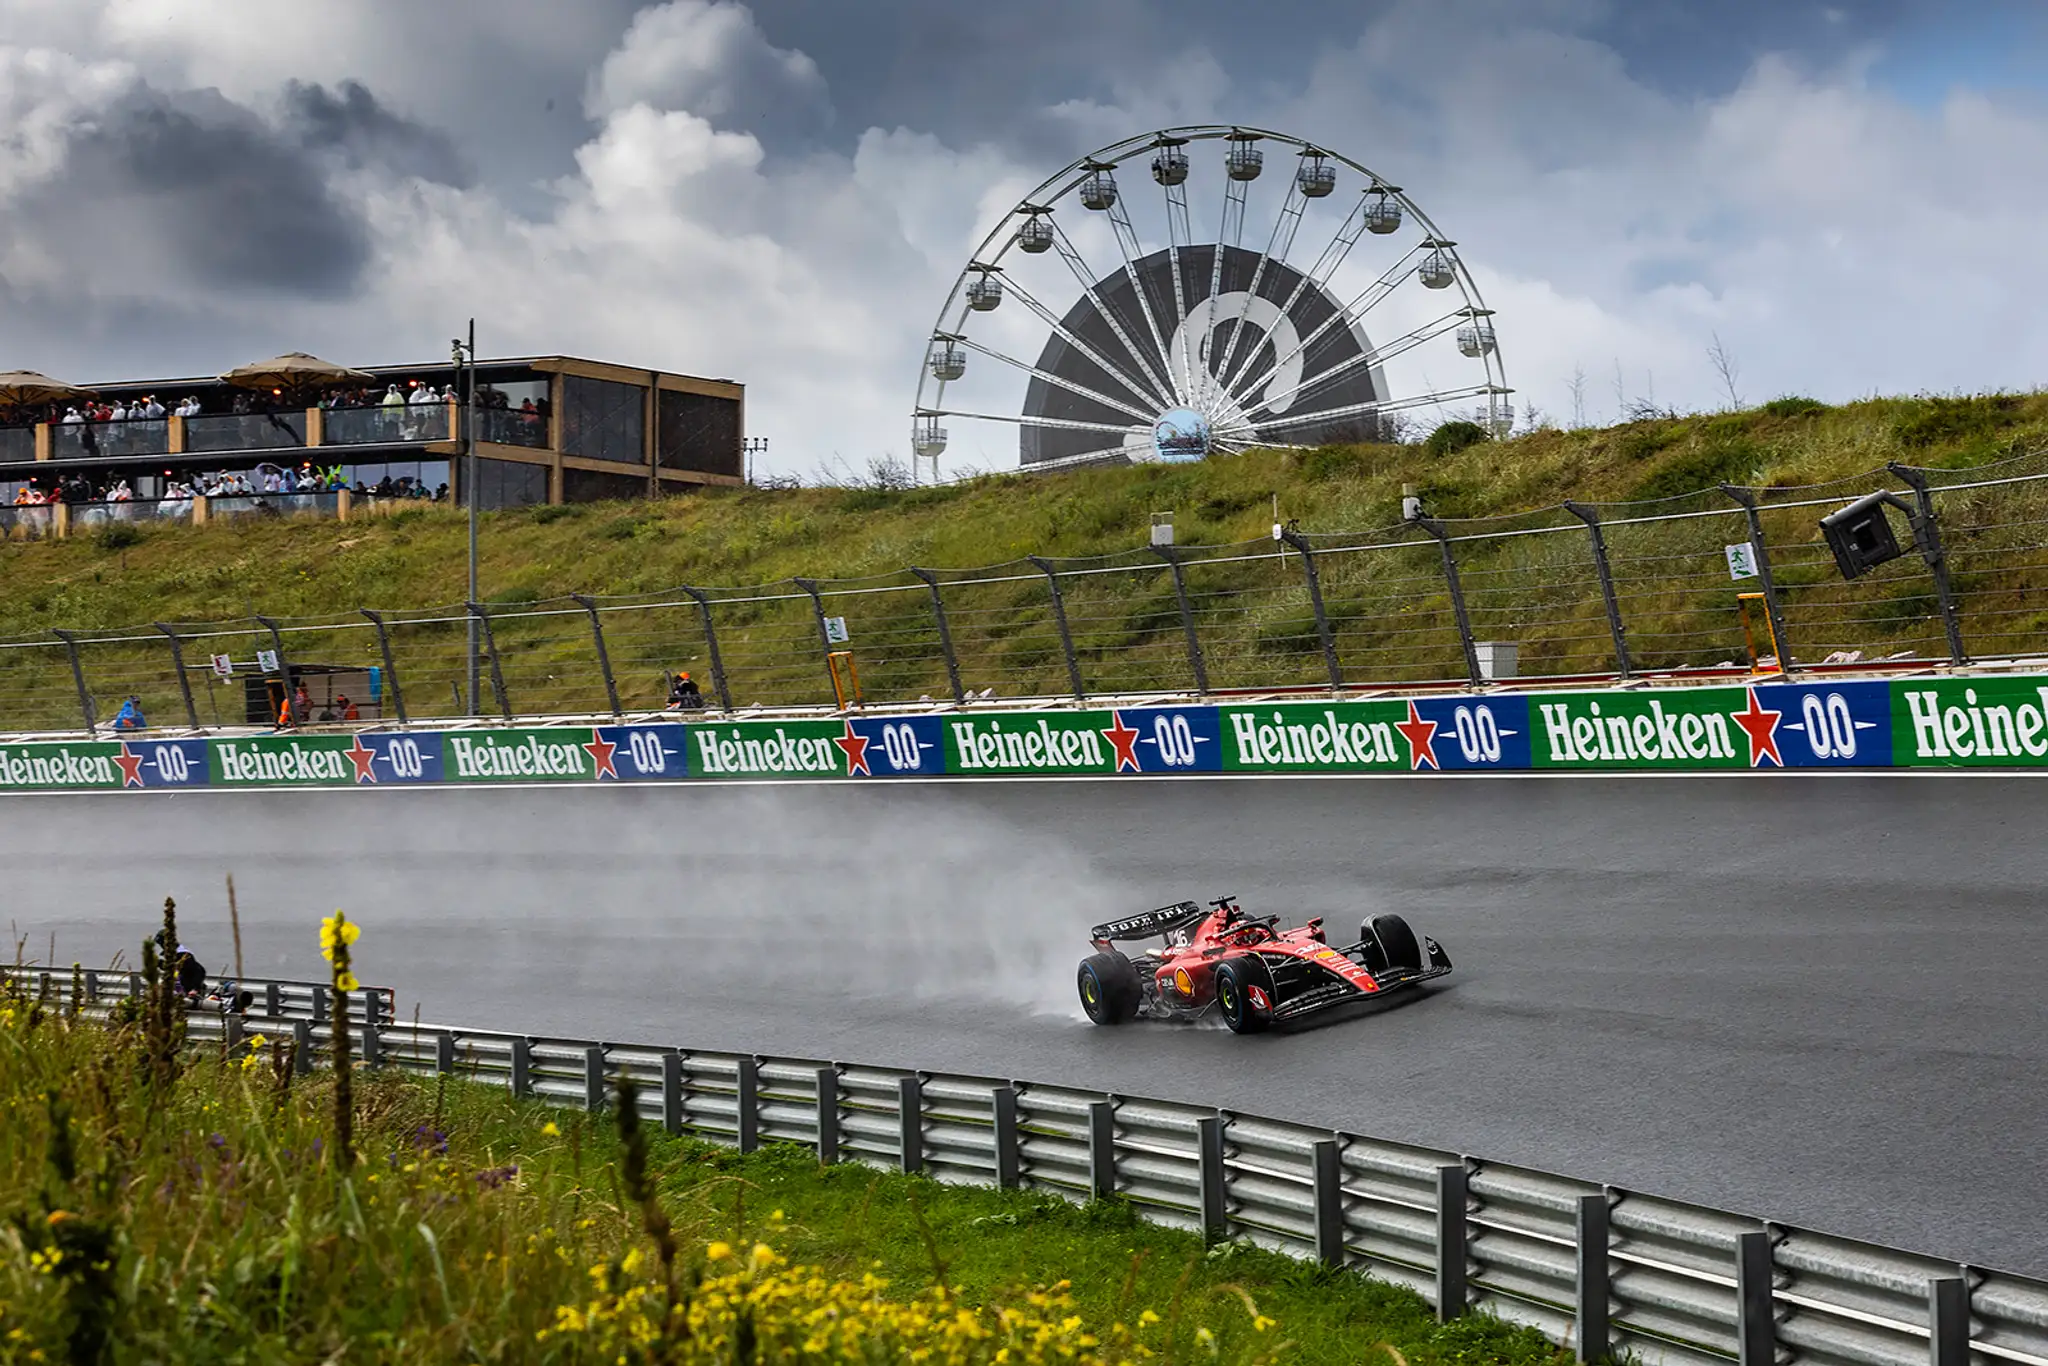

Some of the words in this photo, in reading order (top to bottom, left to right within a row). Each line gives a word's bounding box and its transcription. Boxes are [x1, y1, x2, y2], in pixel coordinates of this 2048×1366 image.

[951, 719, 1105, 768] Heineken
[1229, 710, 1399, 765] Heineken
[1539, 700, 1736, 761] Heineken
[1903, 686, 2048, 758] Heine
[216, 742, 347, 780] Heineken
[450, 735, 587, 777] Heineken
[694, 728, 838, 773] Heineken
